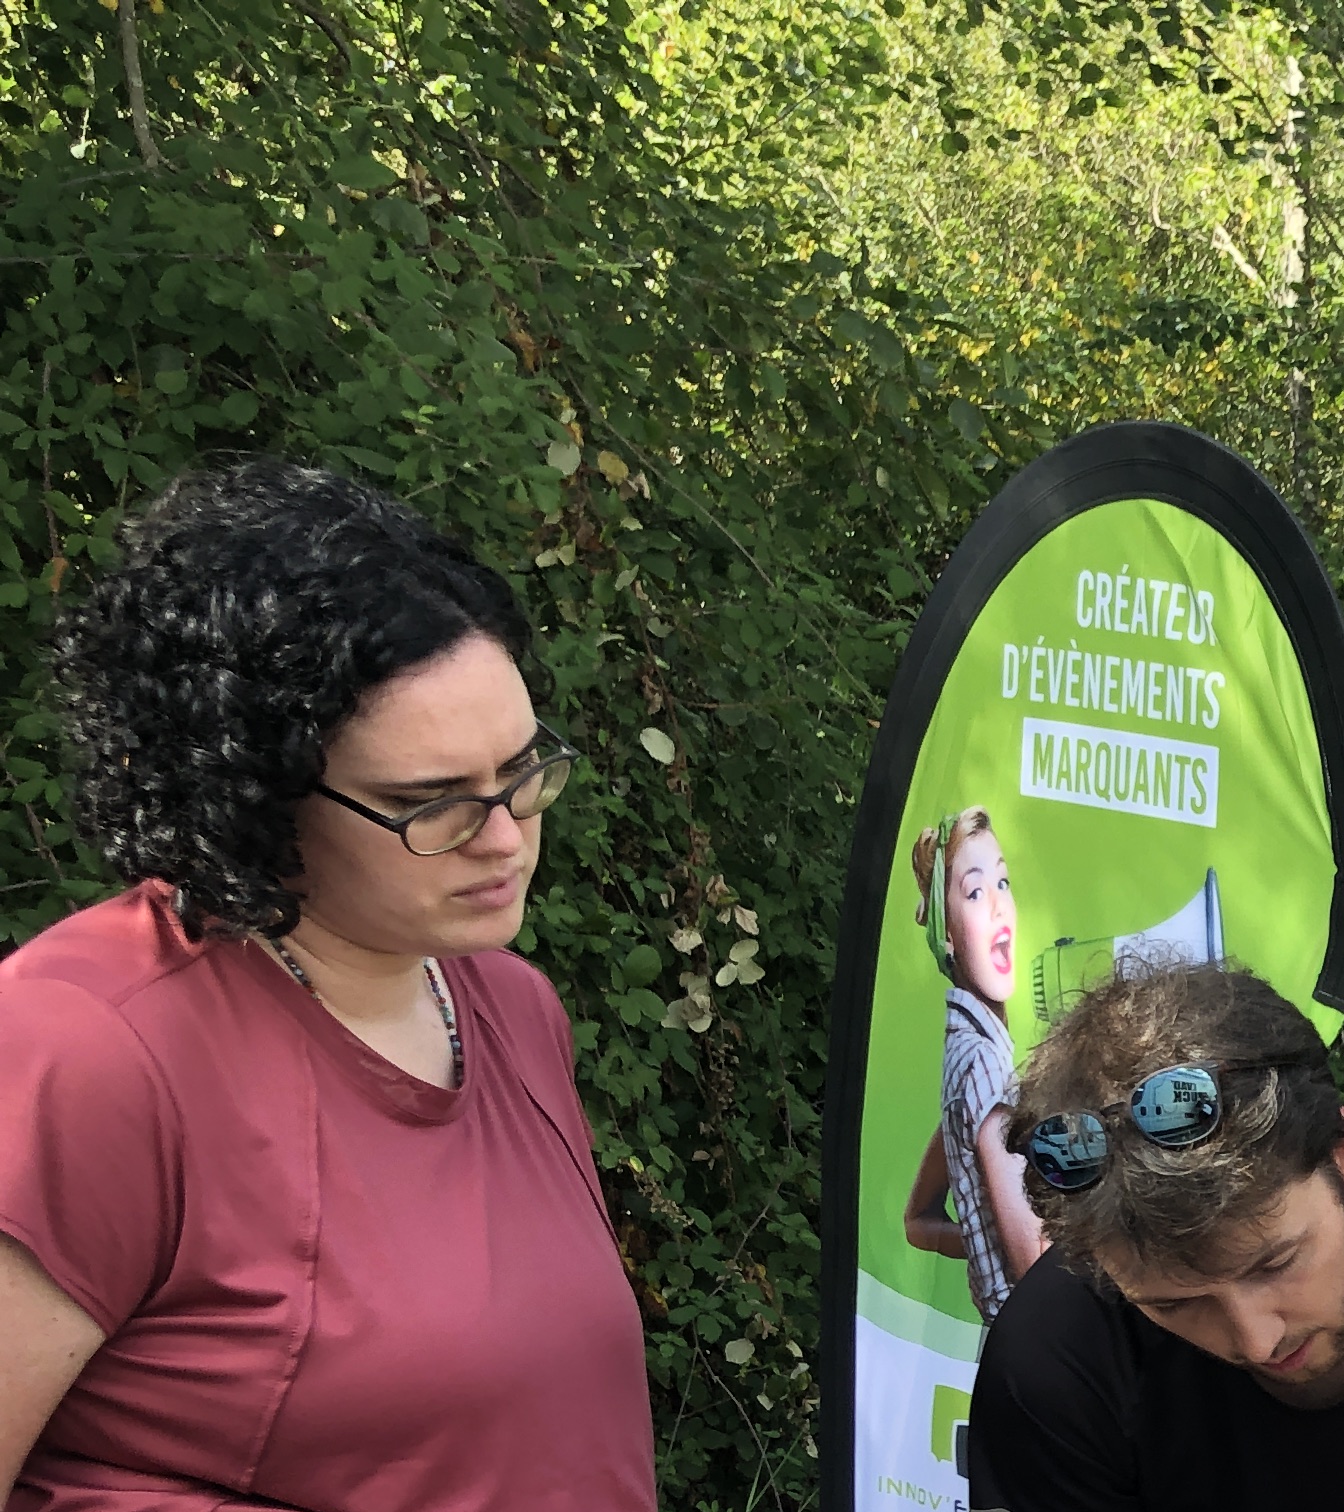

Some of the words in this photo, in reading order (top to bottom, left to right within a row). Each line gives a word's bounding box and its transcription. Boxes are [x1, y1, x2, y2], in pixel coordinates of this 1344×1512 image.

[1076, 564, 1219, 646] CRÉATEUR
[1002, 635, 1226, 729] D'ÉVÈNEMENTS
[1032, 732, 1209, 815] MARQUANTS
